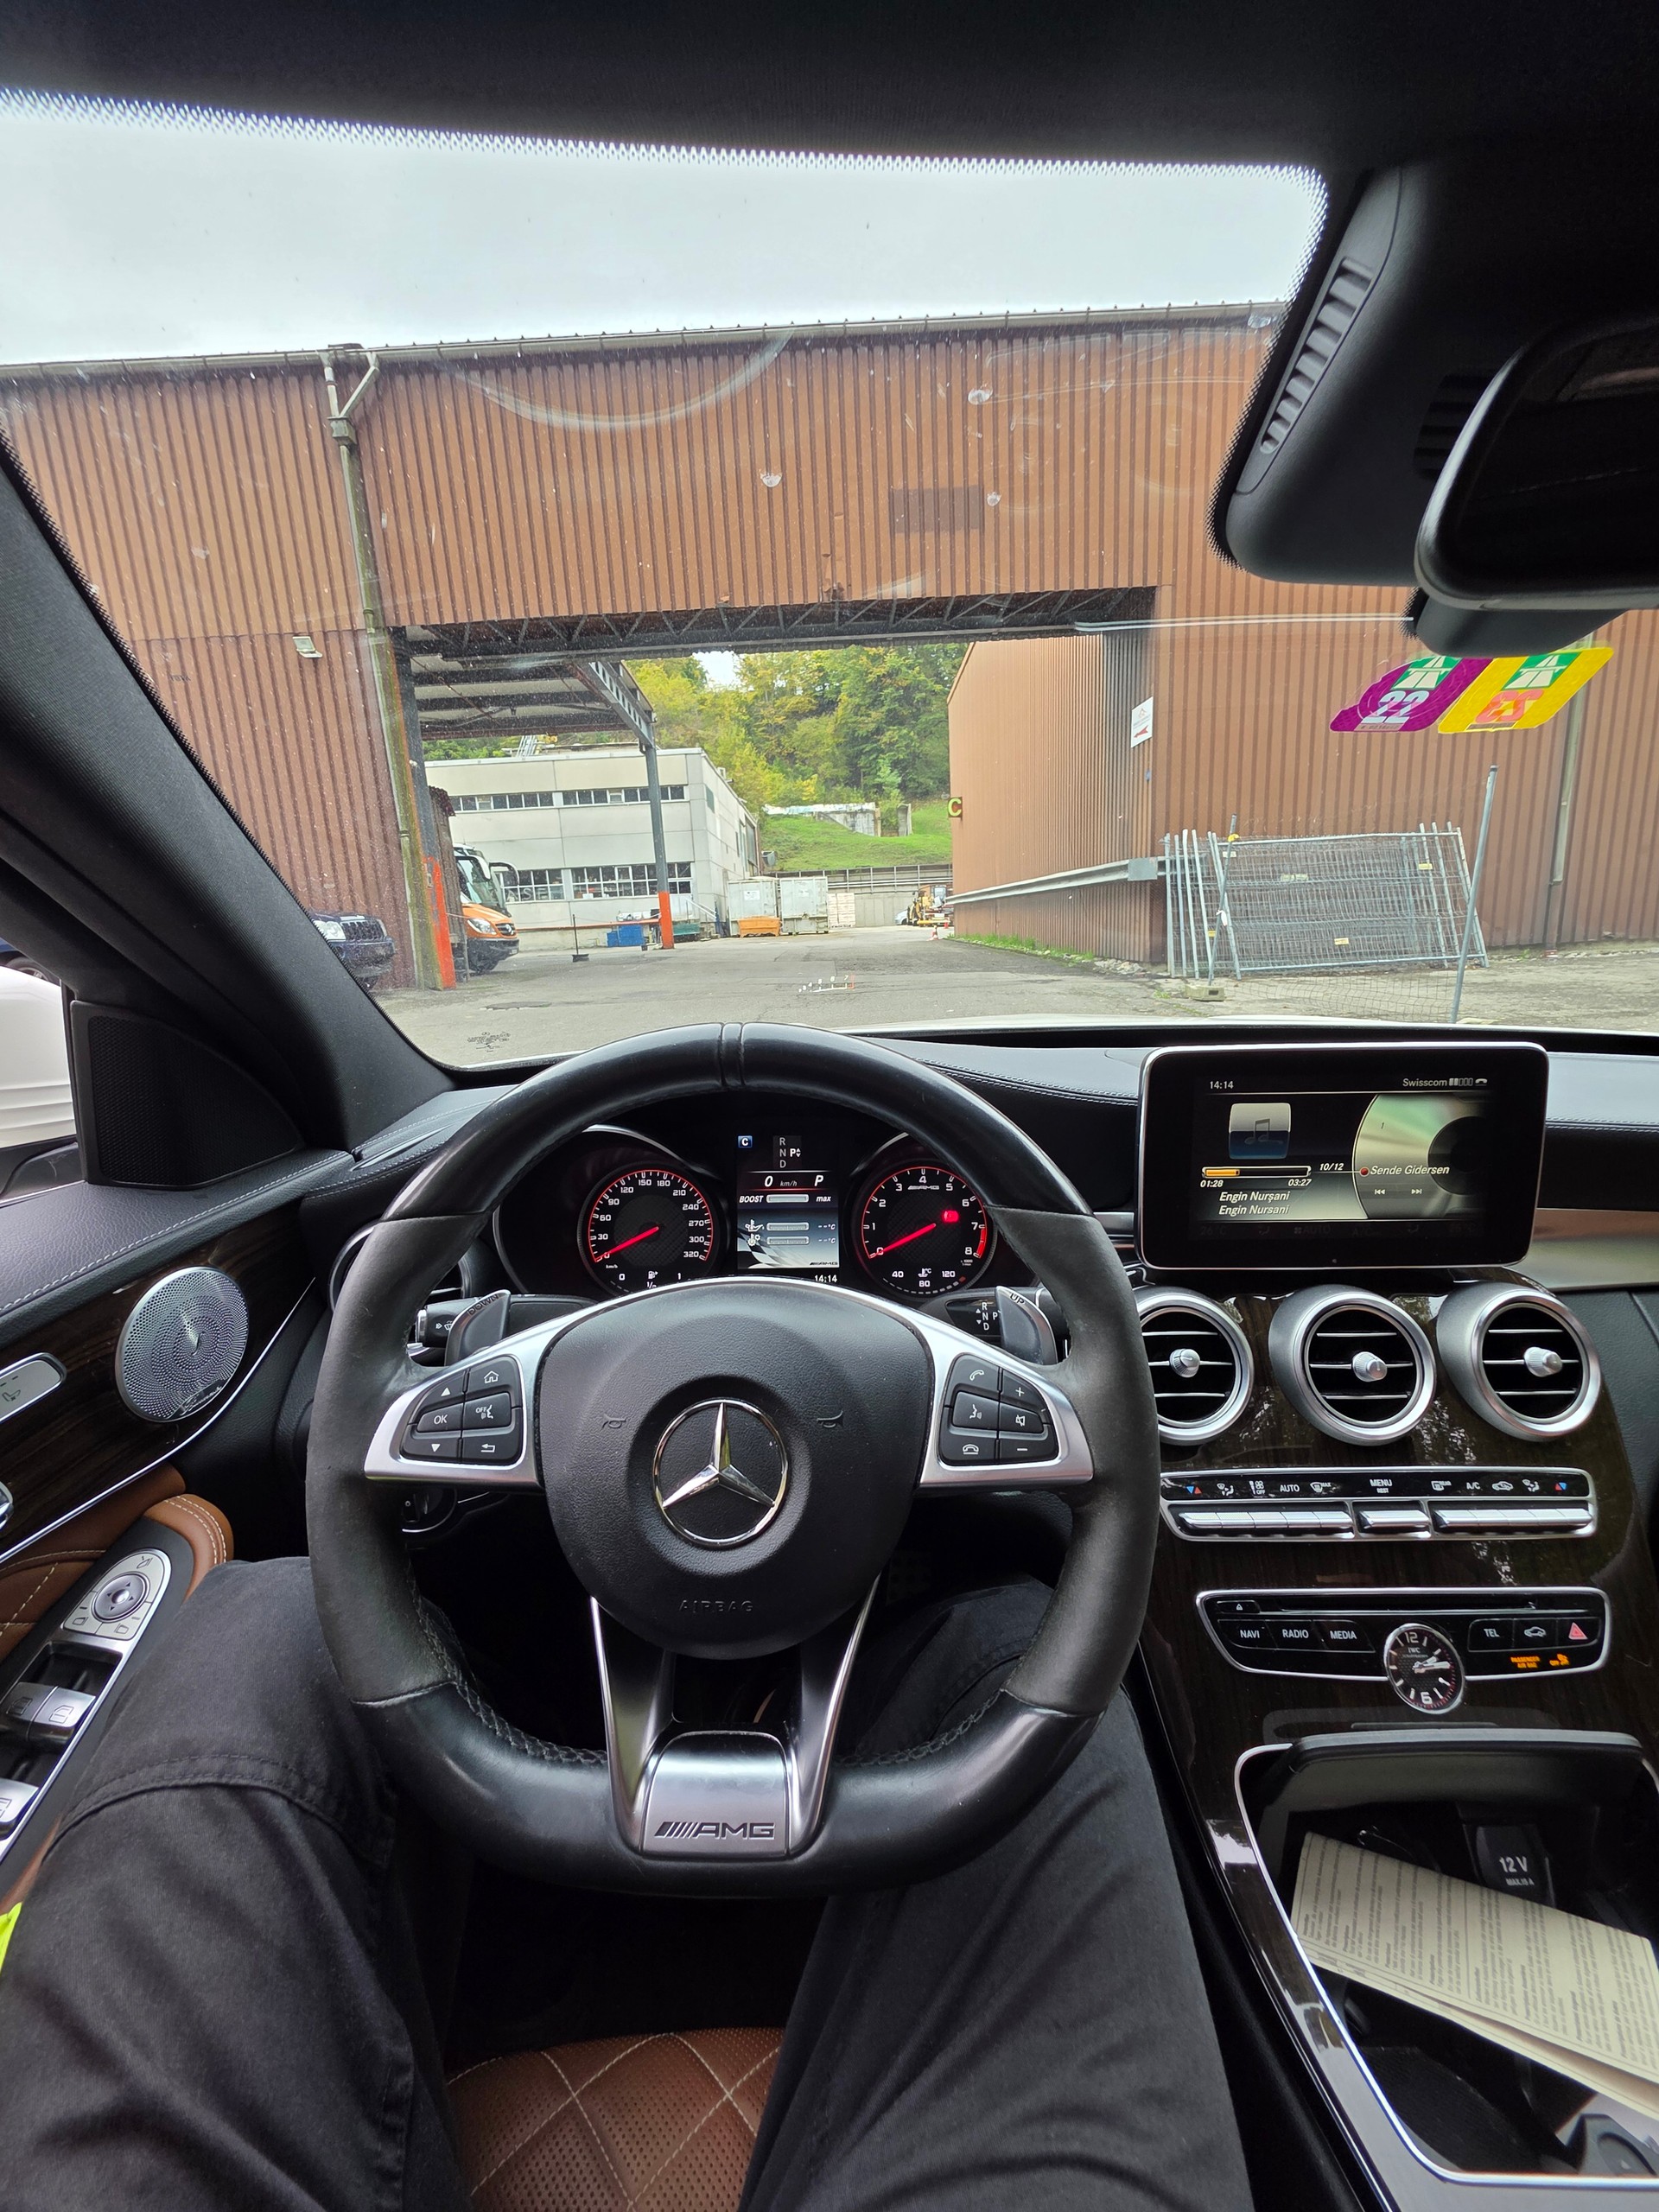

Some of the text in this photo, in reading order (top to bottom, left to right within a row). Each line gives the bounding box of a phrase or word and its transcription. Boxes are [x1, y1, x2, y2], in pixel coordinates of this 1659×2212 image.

[1361, 691, 1429, 723] 22
[948, 798, 962, 817] C
[1210, 1080, 1234, 1089] 14:14
[1402, 1077, 1447, 1086] Swisscom
[741, 1137, 749, 1146] C
[779, 1137, 785, 1146] R
[779, 1148, 796, 1157] N P
[779, 1160, 786, 1168] D
[1370, 1166, 1450, 1175] Sende Gidersen
[765, 1175, 773, 1187] 0
[814, 1175, 823, 1186] P
[1219, 1191, 1291, 1203] Engin Nurşani
[1218, 1205, 1247, 1217] Engin
[1009, 1293, 1026, 1304] UP
[468, 1294, 499, 1316] DOWN
[982, 1301, 988, 1310] R
[993, 1312, 998, 1320] P
[983, 1322, 989, 1331] D
[434, 1414, 448, 1424] OK
[1370, 1478, 1392, 1487] MENU
[1280, 1484, 1300, 1492] AUTO
[678, 1599, 753, 1613] AIRBAG
[1240, 1630, 1260, 1638] NAVI
[1282, 1629, 1309, 1638] RADIO
[1330, 1630, 1357, 1639] MEDIA
[1405, 1631, 1419, 1643] 12
[1484, 1629, 1500, 1637] TEL
[1421, 1691, 1433, 1704] 6
[692, 1821, 775, 1840] AMG
[1499, 1856, 1528, 1872] 12 V
